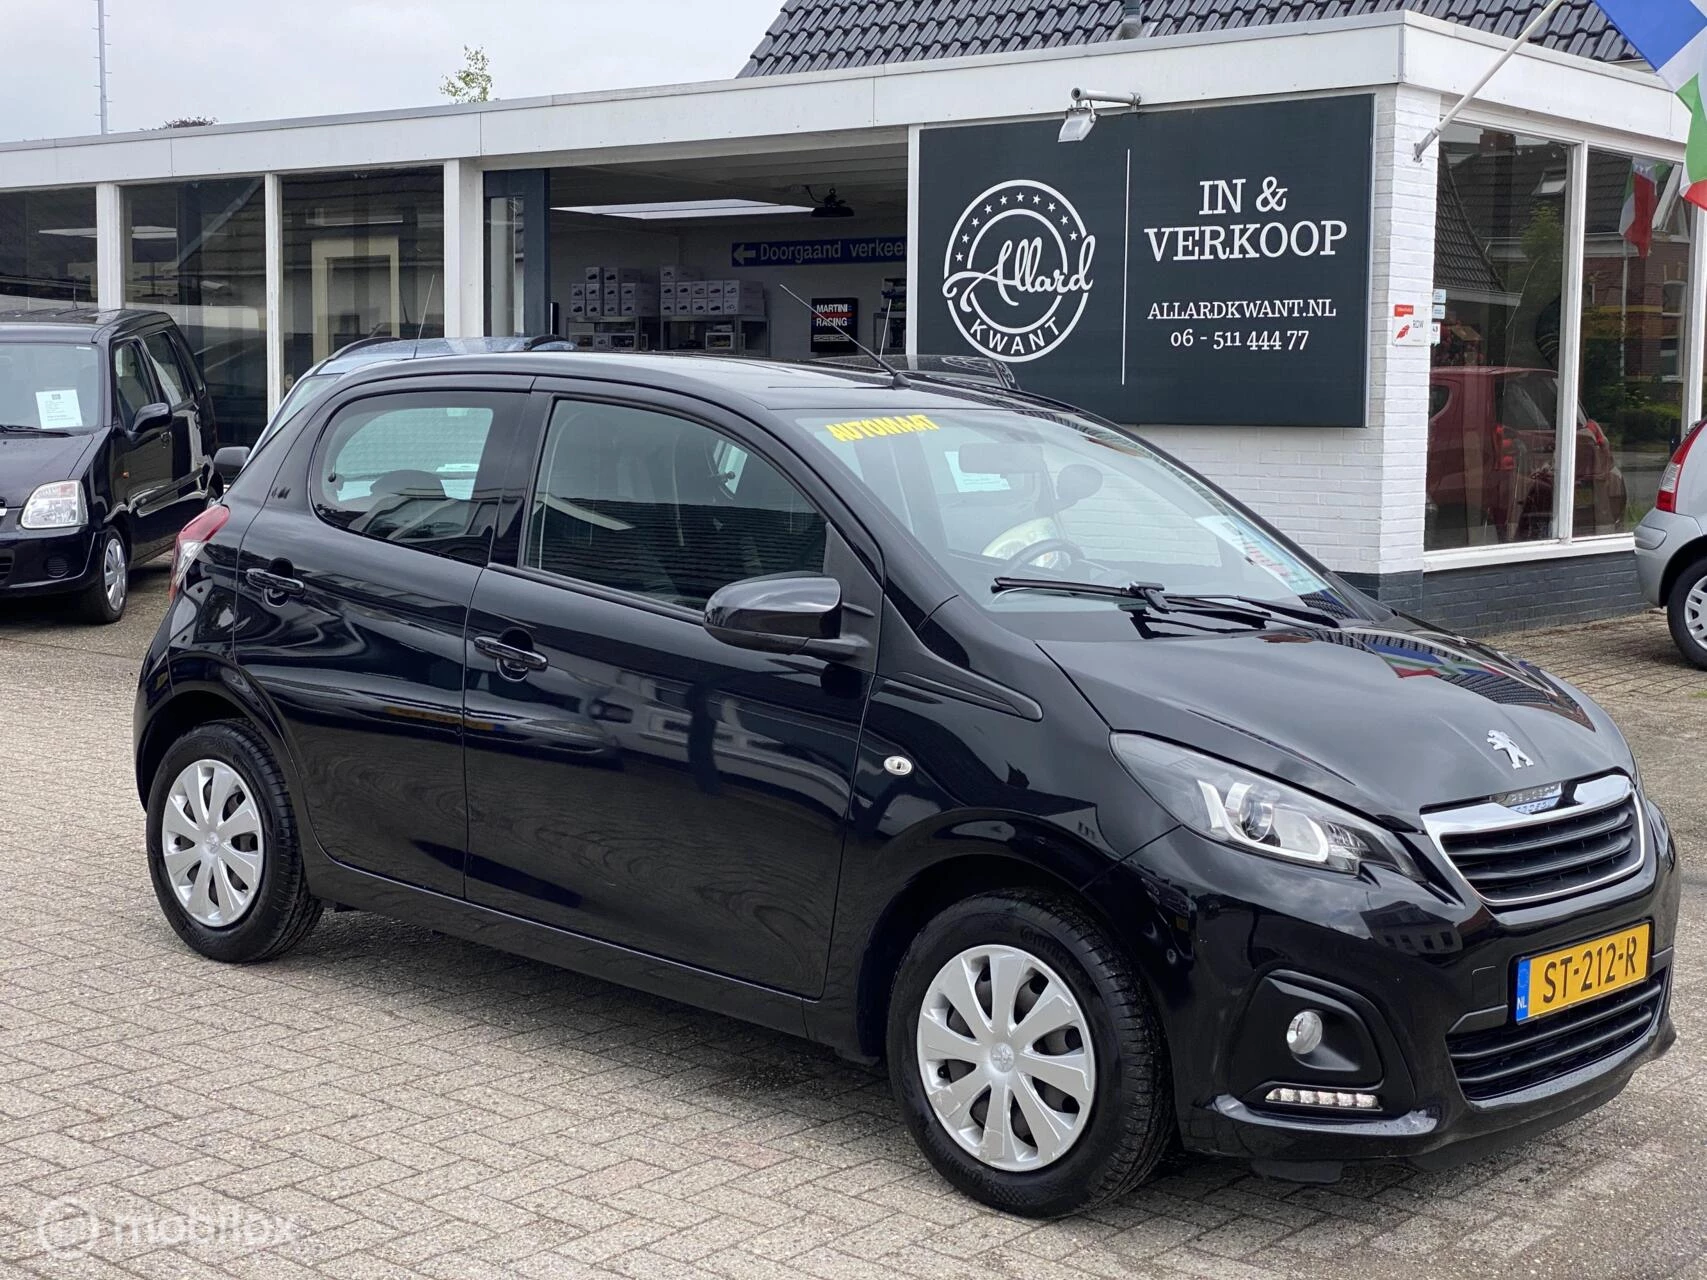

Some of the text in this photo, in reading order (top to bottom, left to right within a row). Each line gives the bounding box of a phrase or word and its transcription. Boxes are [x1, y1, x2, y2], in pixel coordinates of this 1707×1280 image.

[1198, 176, 1287, 215] IN &
[760, 239, 907, 264] Doorgaand verkee
[1143, 220, 1348, 262] VERKOOP
[942, 234, 1096, 313] Allard
[816, 304, 849, 313] MARTINI
[1147, 298, 1337, 321] ALLARDKWANT.NL
[969, 316, 1060, 355] KWANT
[1170, 329, 1194, 348] 06
[1213, 332, 1241, 351] 511
[1246, 331, 1282, 352] 444
[1286, 330, 1310, 351] 77
[825, 413, 941, 442] AUTOMAAT
[1542, 935, 1637, 1004] ST-212-R
[1516, 998, 1528, 1010] NL
